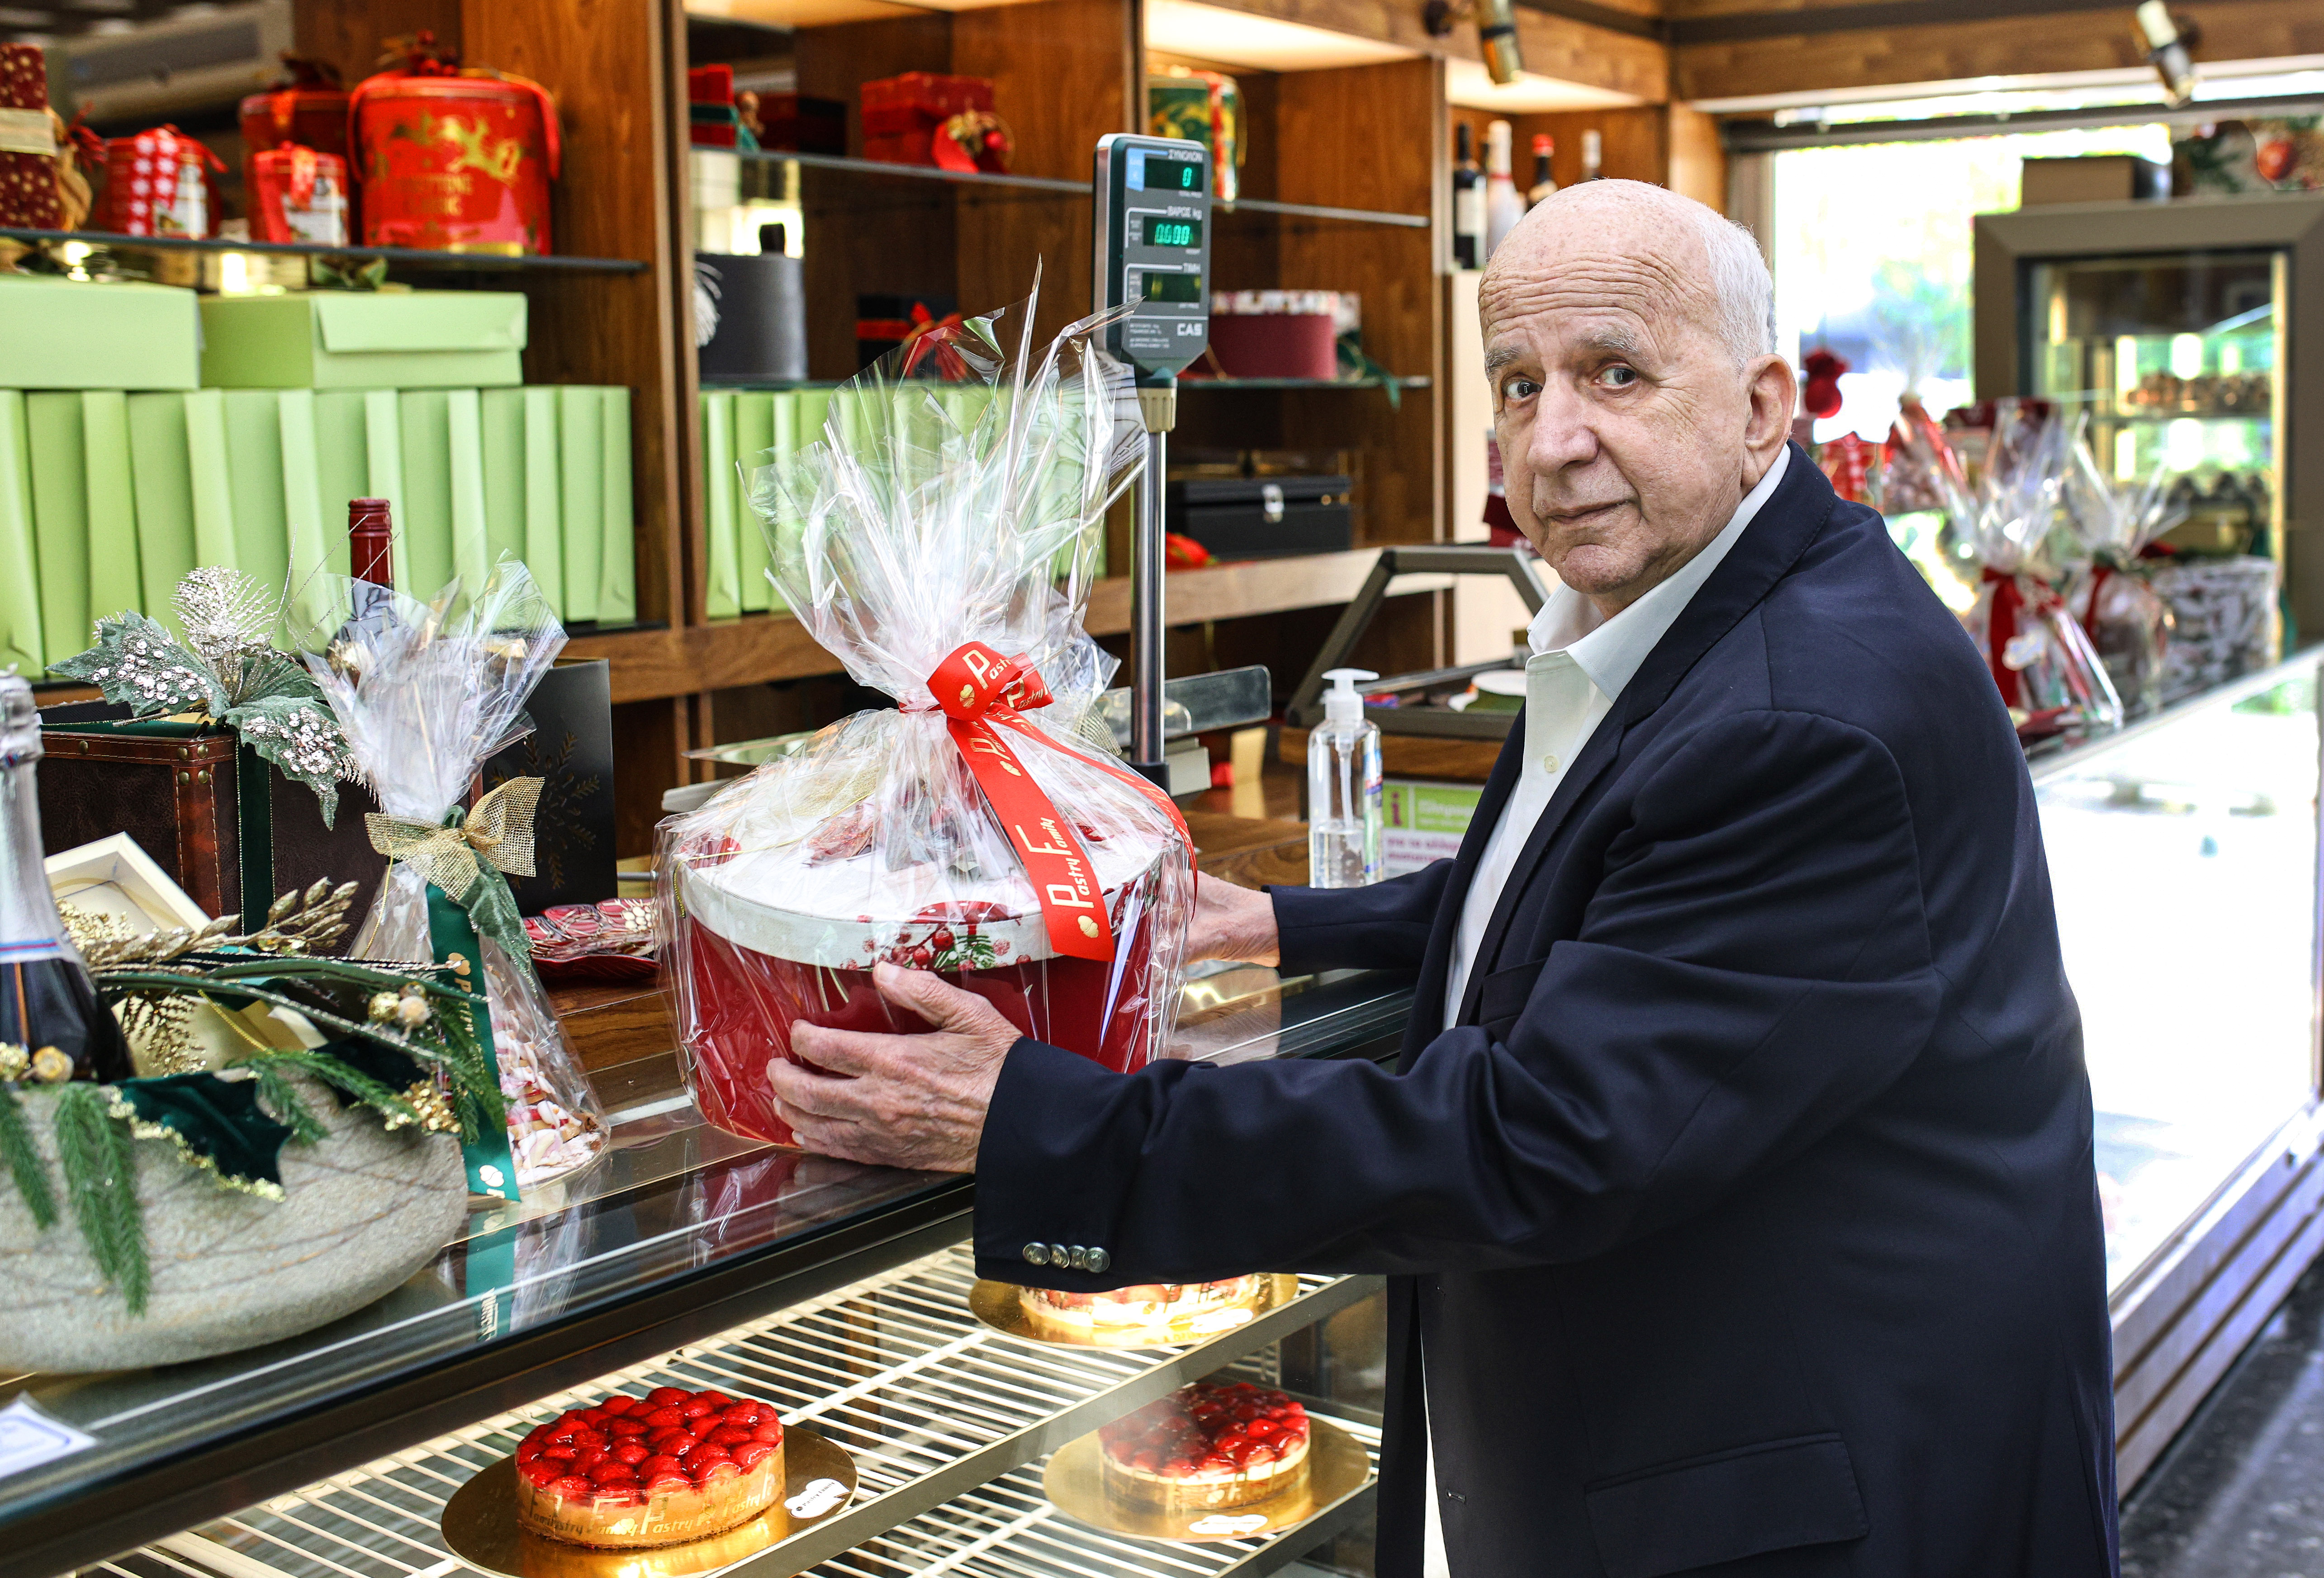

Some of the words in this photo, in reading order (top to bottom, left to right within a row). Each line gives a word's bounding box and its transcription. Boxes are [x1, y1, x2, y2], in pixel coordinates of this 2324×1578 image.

[1182, 167, 1192, 187] 0
[1177, 322, 1203, 336] CAS
[962, 649, 1013, 691] Pastr
[1015, 817, 1073, 856] Family
[1046, 858, 1095, 909] Pastry
[640, 1497, 694, 1535] Pastry
[802, 1494, 820, 1506] Pastry
